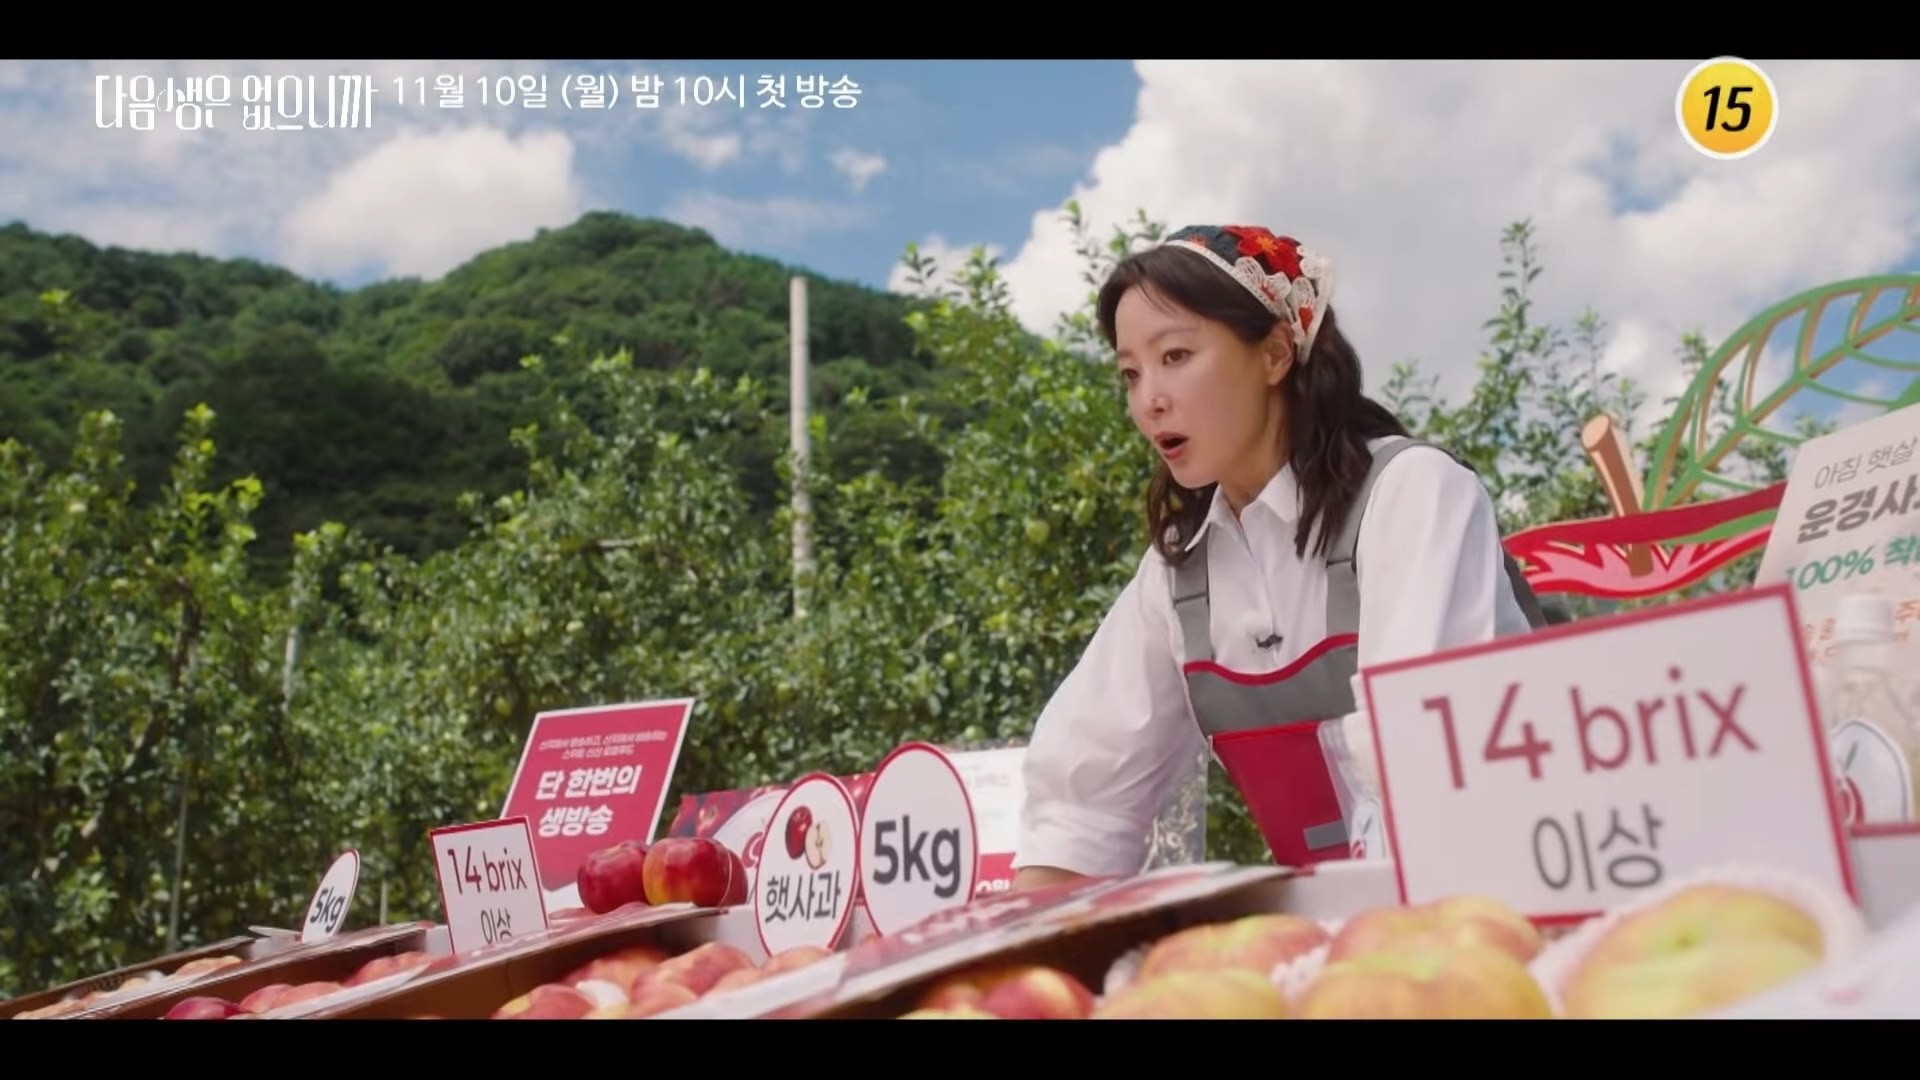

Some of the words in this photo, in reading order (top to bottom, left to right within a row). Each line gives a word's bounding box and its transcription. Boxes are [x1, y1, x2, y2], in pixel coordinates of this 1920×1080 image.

[1814, 453, 1862, 489] 아침
[1867, 436, 1918, 474] 햇살
[1796, 474, 1920, 544] 운경사
[1421, 681, 1553, 790] 14
[1568, 665, 1761, 774] brix
[535, 770, 565, 800] 단
[564, 764, 643, 798] 한번의
[538, 804, 614, 837] 생방송
[447, 846, 482, 895] 14
[483, 848, 528, 892] brix
[872, 815, 961, 899] 5kg
[1531, 804, 1664, 892] 이상
[310, 886, 345, 934] 5kg
[765, 869, 842, 924] 햇사과
[480, 908, 513, 945] 이상
